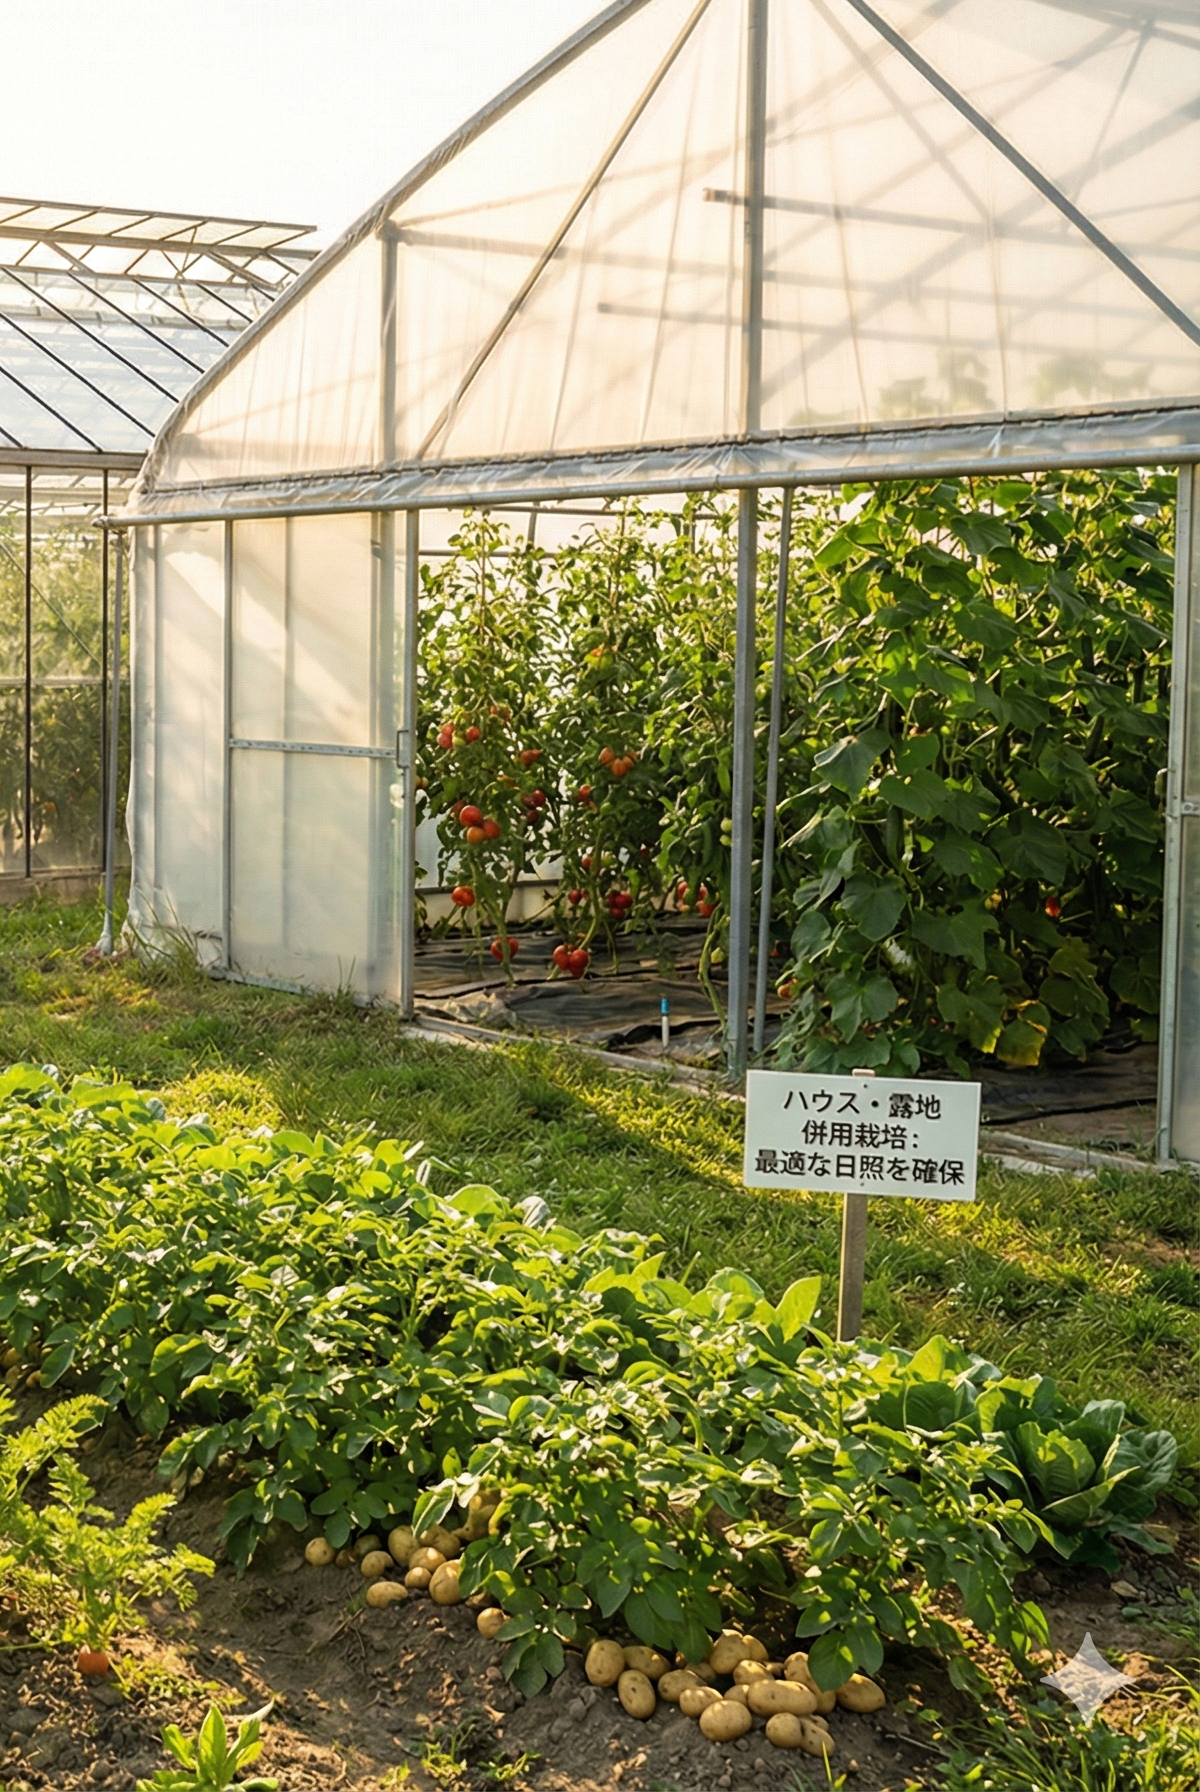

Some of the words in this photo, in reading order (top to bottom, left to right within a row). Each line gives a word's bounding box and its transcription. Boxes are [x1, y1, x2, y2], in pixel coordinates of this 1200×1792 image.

[783, 1090, 941, 1119] ハウス・露地
[755, 1149, 964, 1185] 最適な日照を確保
